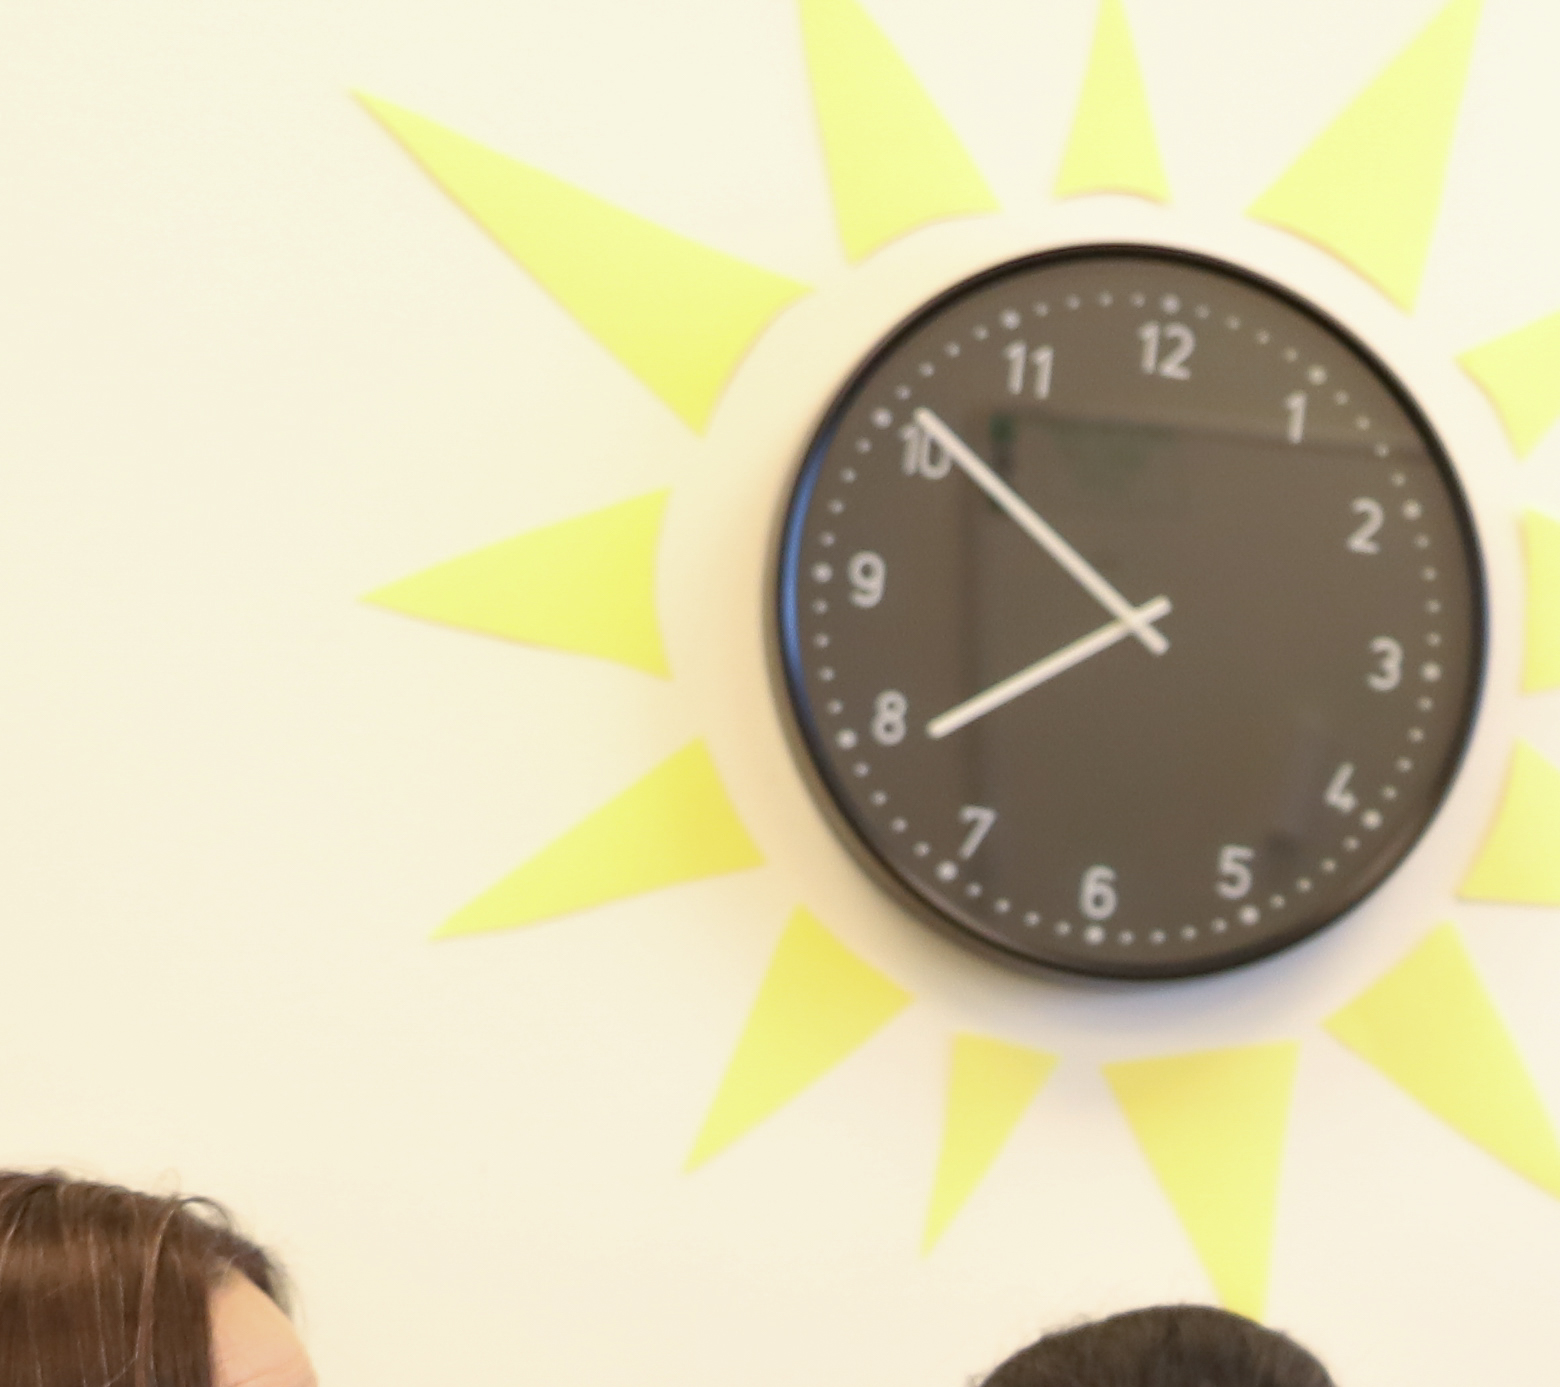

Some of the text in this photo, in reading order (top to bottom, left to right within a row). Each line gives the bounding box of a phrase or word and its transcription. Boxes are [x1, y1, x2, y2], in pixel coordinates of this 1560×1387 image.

[1005, 342, 1054, 399] 11
[1139, 322, 1195, 381] 12
[1285, 392, 1307, 444] 1
[899, 424, 954, 480] 10
[1347, 497, 1384, 554] 2
[848, 551, 886, 608] 9
[1368, 636, 1403, 691] 3
[872, 690, 908, 746] 8
[1325, 763, 1356, 813] 4
[959, 805, 997, 859] 7
[1080, 865, 1117, 921] 6
[1217, 844, 1254, 900] 5
